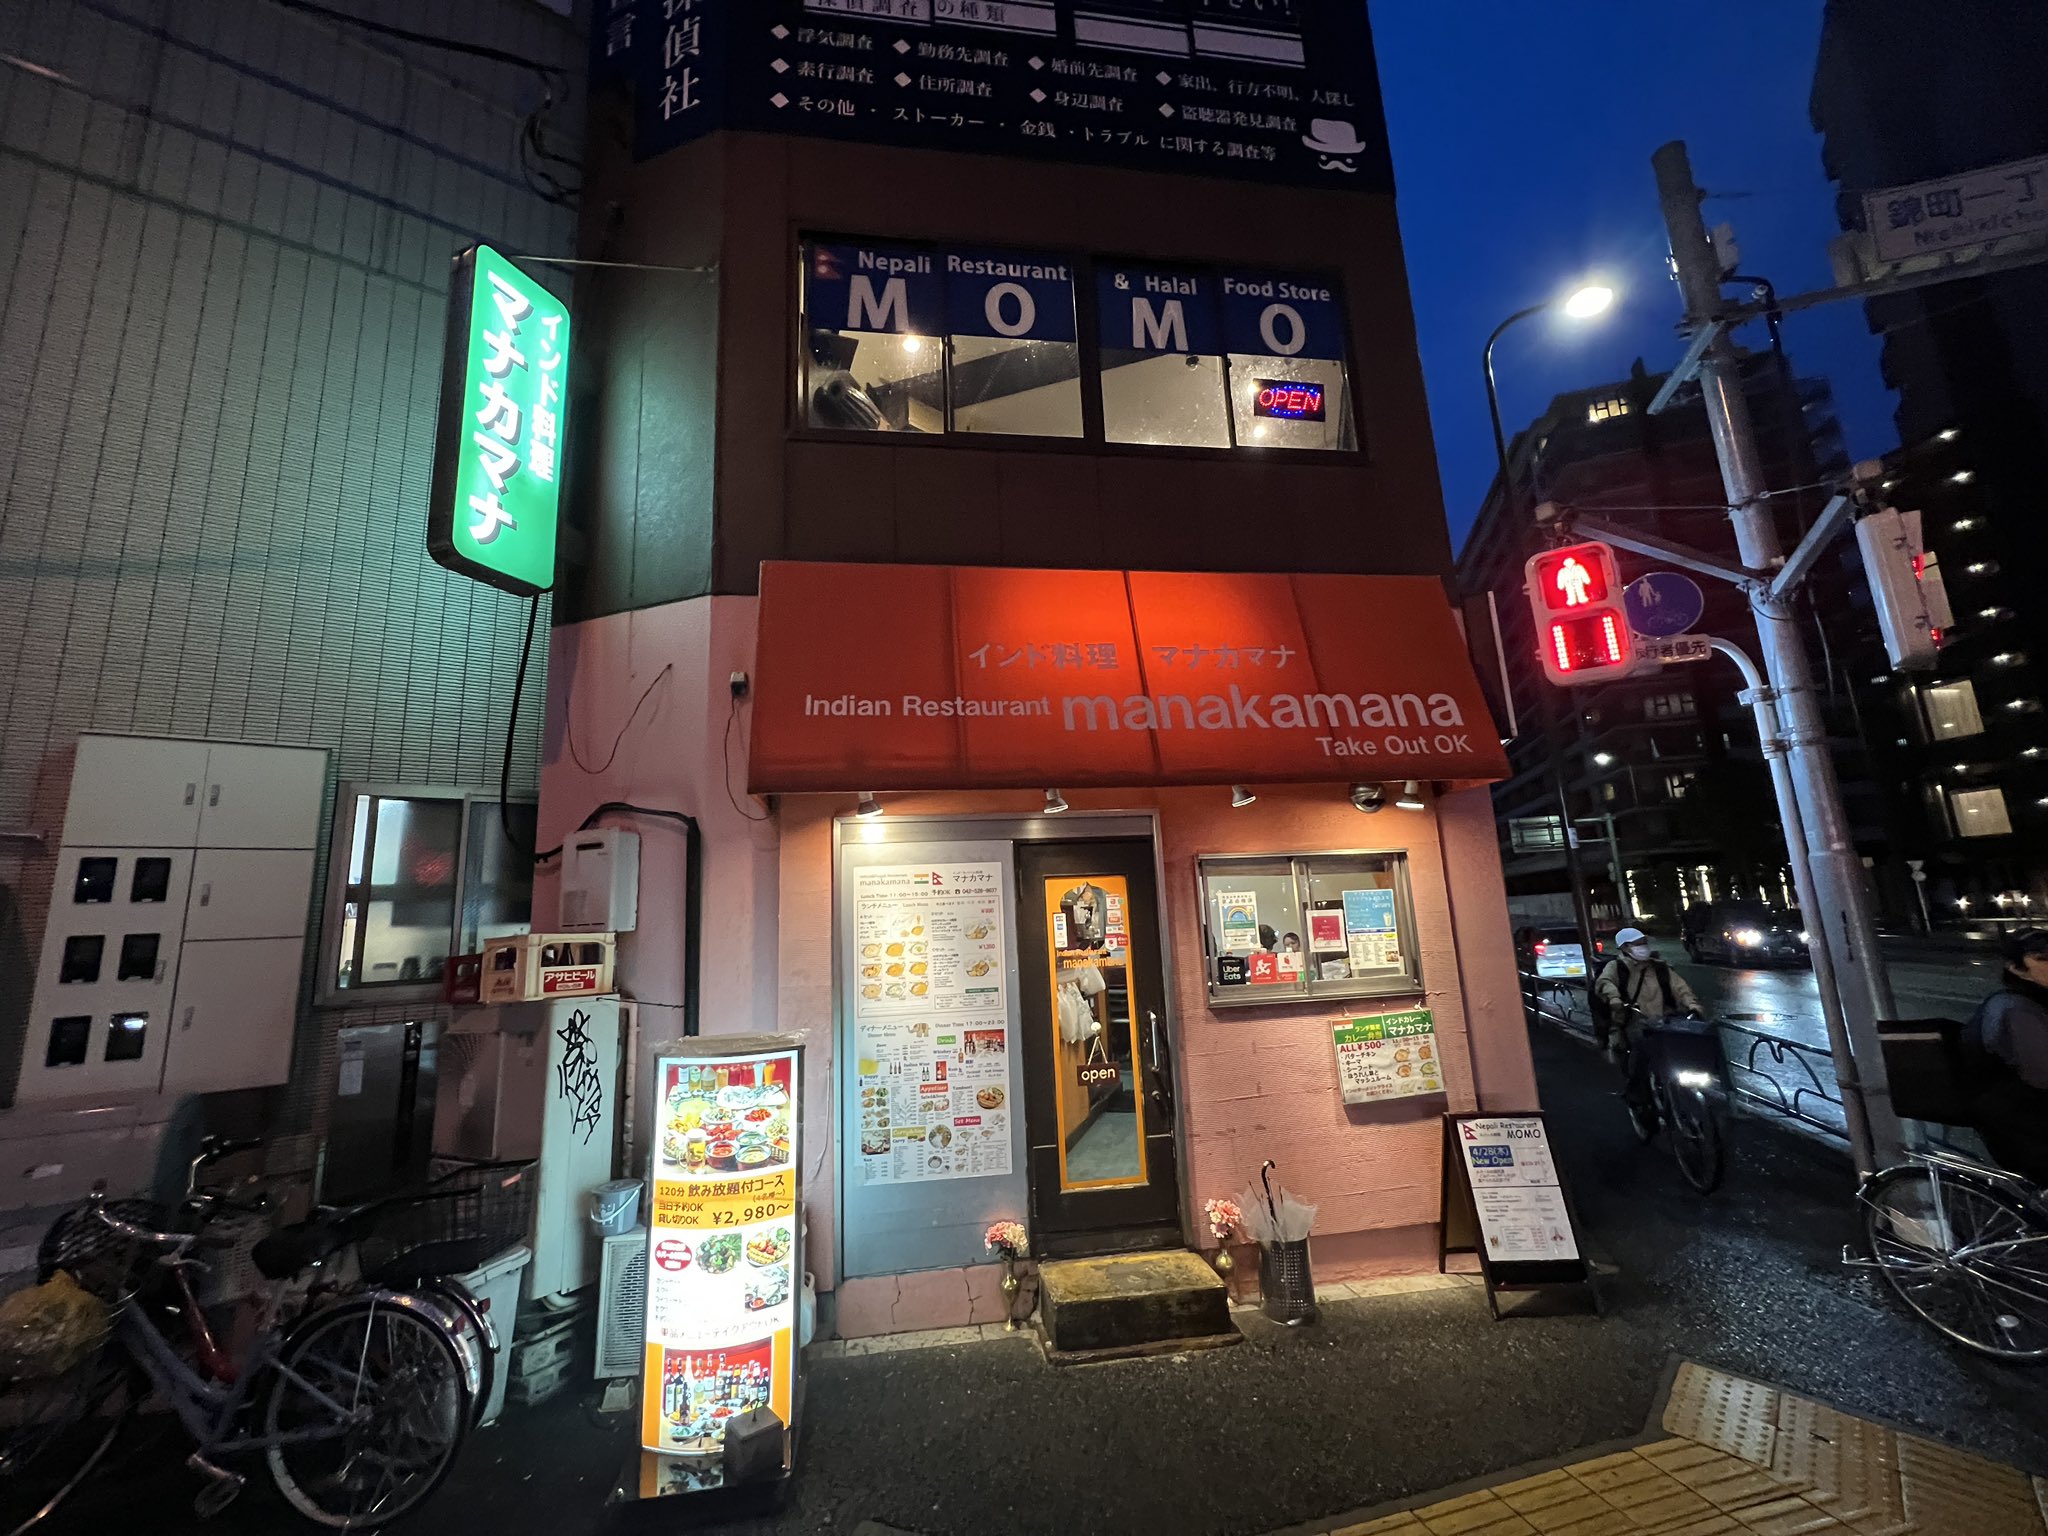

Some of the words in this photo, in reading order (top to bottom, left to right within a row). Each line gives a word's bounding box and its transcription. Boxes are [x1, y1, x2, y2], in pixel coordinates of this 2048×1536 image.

[919, 73, 993, 98] 住所調査
[799, 95, 857, 117] その他
[858, 249, 931, 275] Nepali
[947, 255, 1068, 282] Restaurant
[1114, 272, 1131, 291] &
[1145, 275, 1198, 296] Halal
[1223, 276, 1275, 298] Food
[1279, 281, 1331, 302] Store
[468, 269, 534, 545] マナカマナ
[1258, 387, 1322, 412] OPEN
[967, 641, 1120, 671] インド料理
[1149, 644, 1297, 671] マナカマナ
[805, 693, 891, 718] Indian
[902, 694, 1050, 718] Restaurant
[1060, 682, 1465, 733] manakamana
[1315, 735, 1379, 758] Take
[1384, 734, 1430, 757] Out
[1433, 733, 1474, 756] OK
[544, 970, 596, 983] アサヒビール
[1222, 965, 1240, 973] Uber
[1223, 972, 1241, 980] Eats
[1387, 1021, 1432, 1036] マナカマナ
[1506, 1128, 1541, 1139] MOMO
[659, 1186, 685, 1197] 120分
